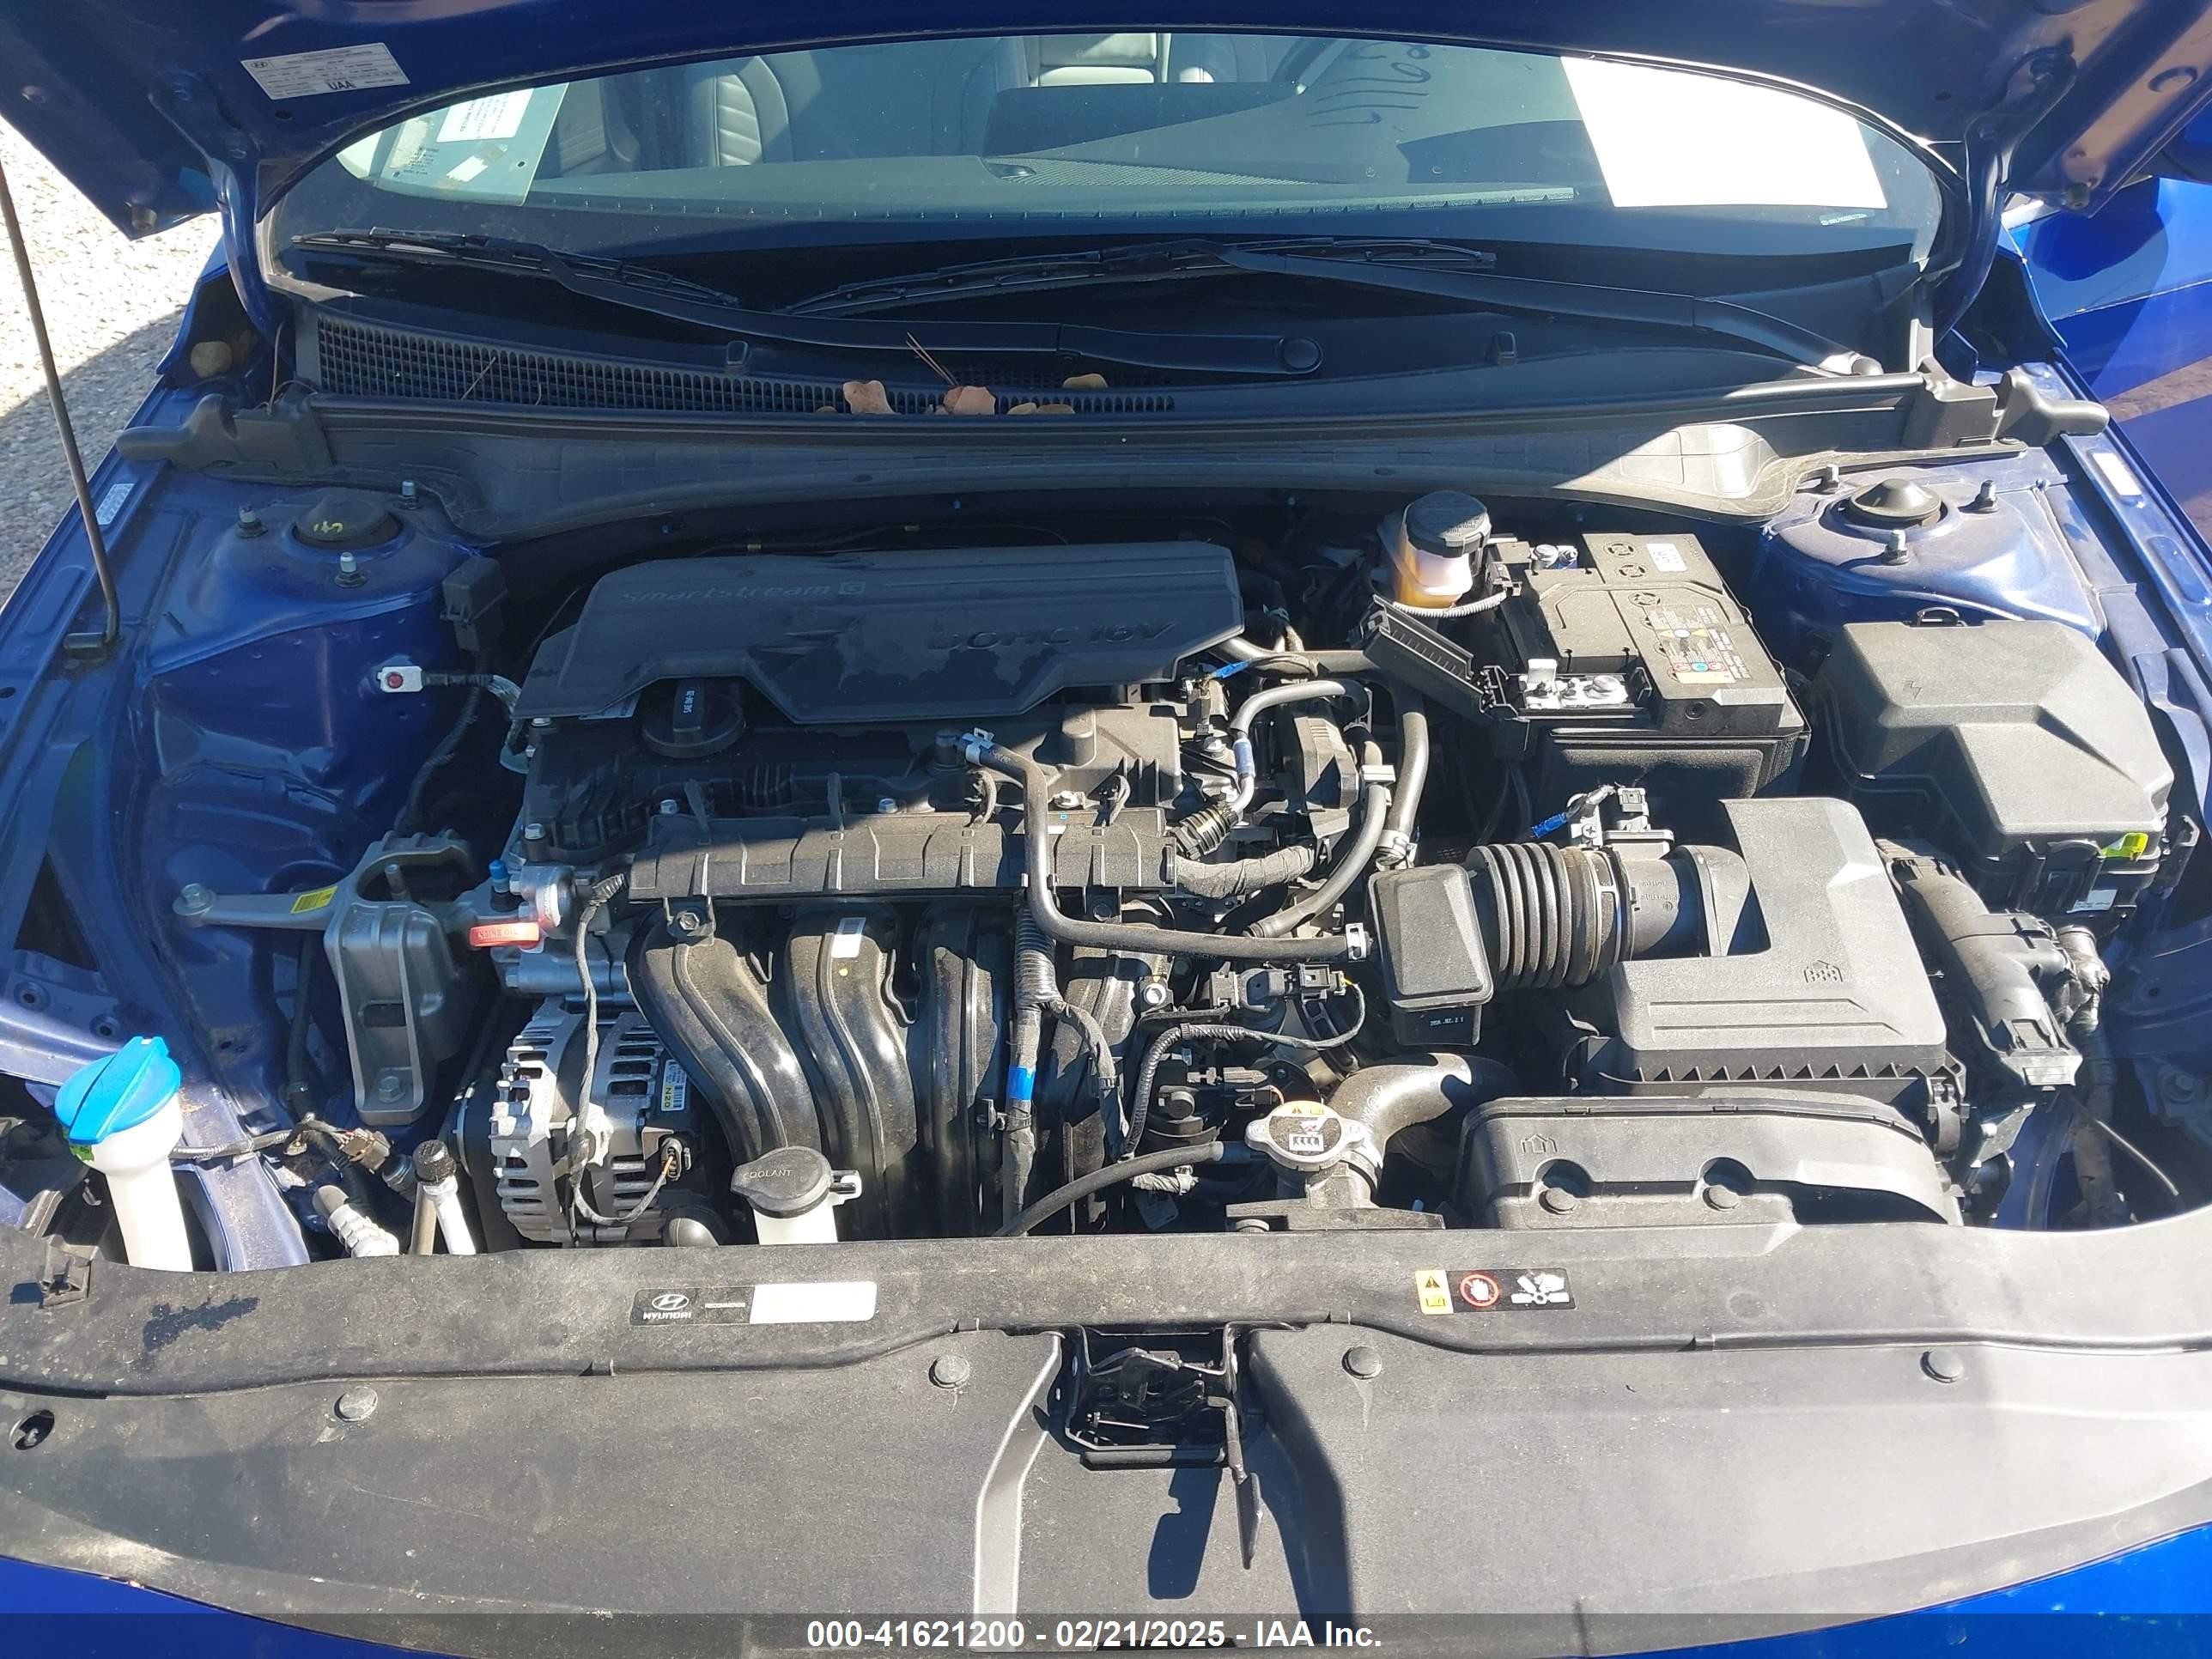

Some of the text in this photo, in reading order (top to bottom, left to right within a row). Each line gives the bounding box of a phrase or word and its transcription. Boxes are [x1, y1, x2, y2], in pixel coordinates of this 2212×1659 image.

[325, 81, 356, 91] UAA
[621, 586, 831, 602] Smartstream
[926, 621, 1176, 650] DOHC 16V
[743, 1169, 793, 1180] COOLANT
[642, 1311, 692, 1321] HYUNDAI
